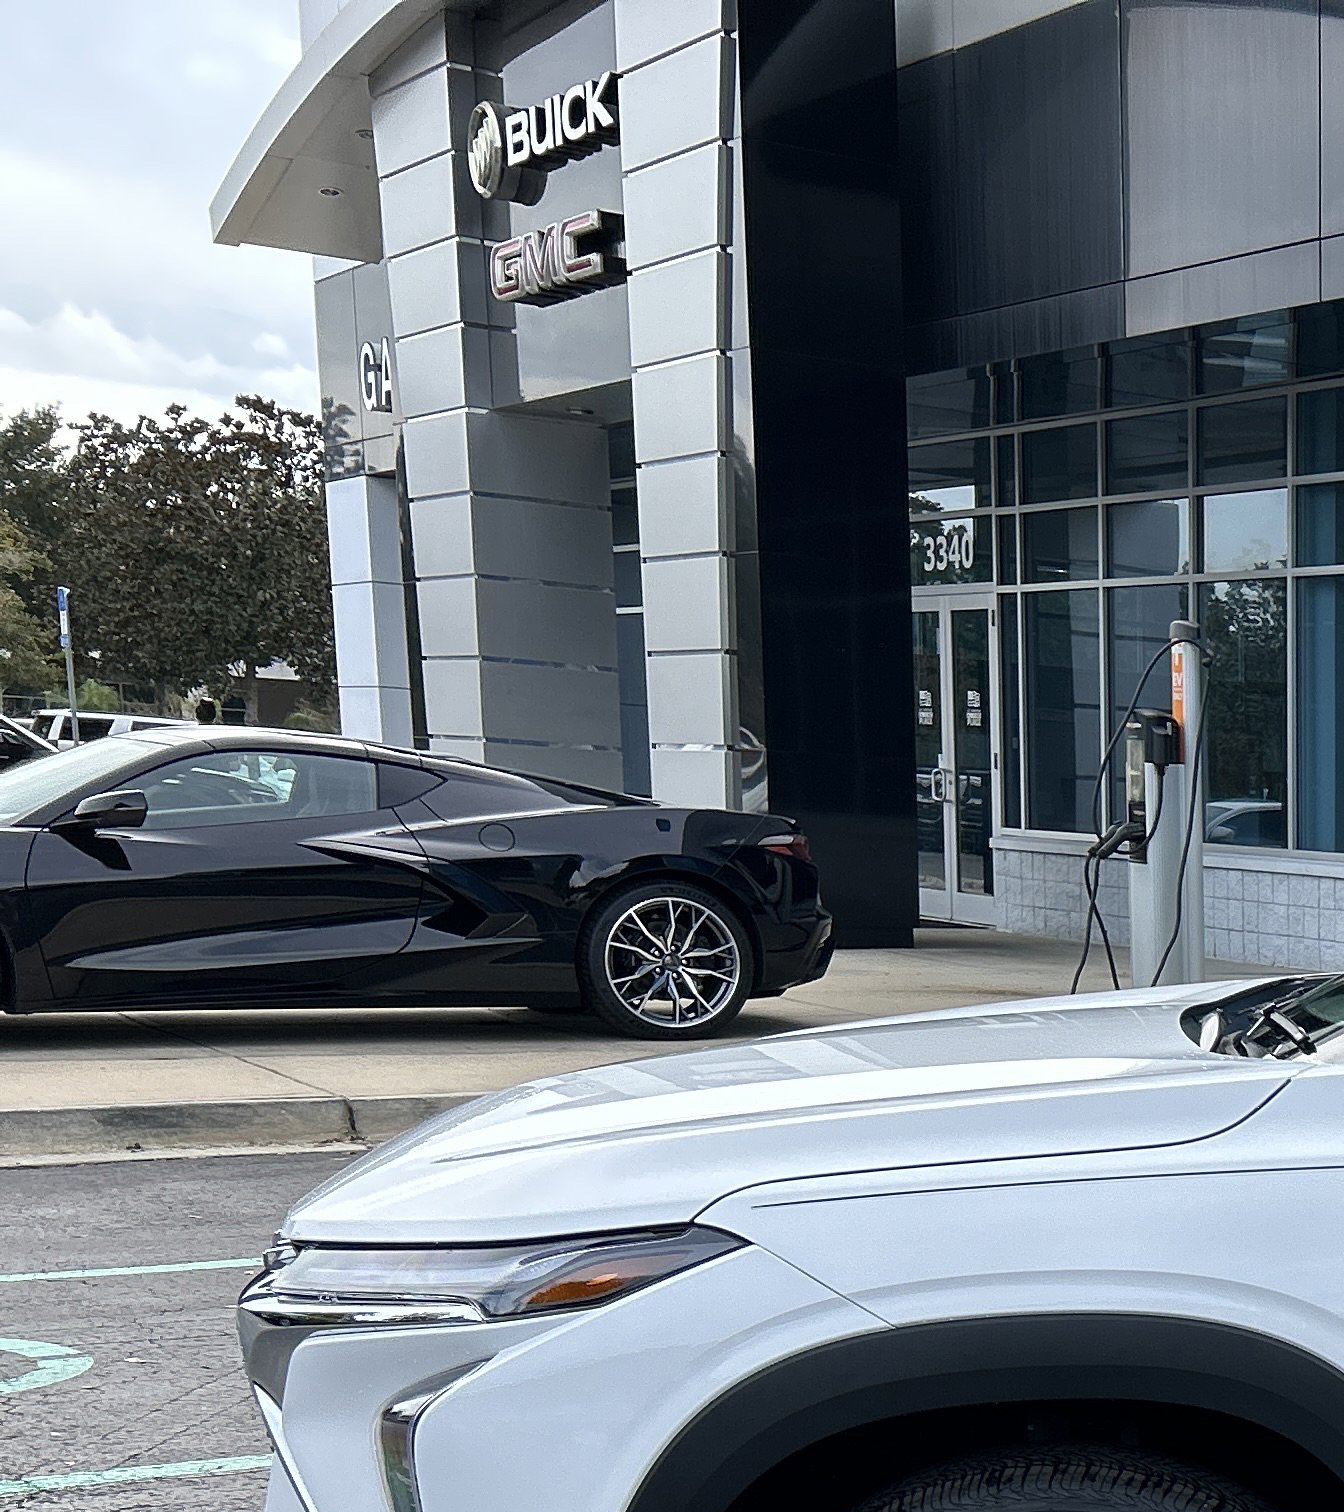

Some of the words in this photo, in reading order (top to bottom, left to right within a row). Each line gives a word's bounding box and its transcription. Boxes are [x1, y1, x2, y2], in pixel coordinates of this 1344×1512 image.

[504, 71, 614, 167] BUICK
[490, 208, 605, 302] GMC
[923, 532, 974, 572] 3340
